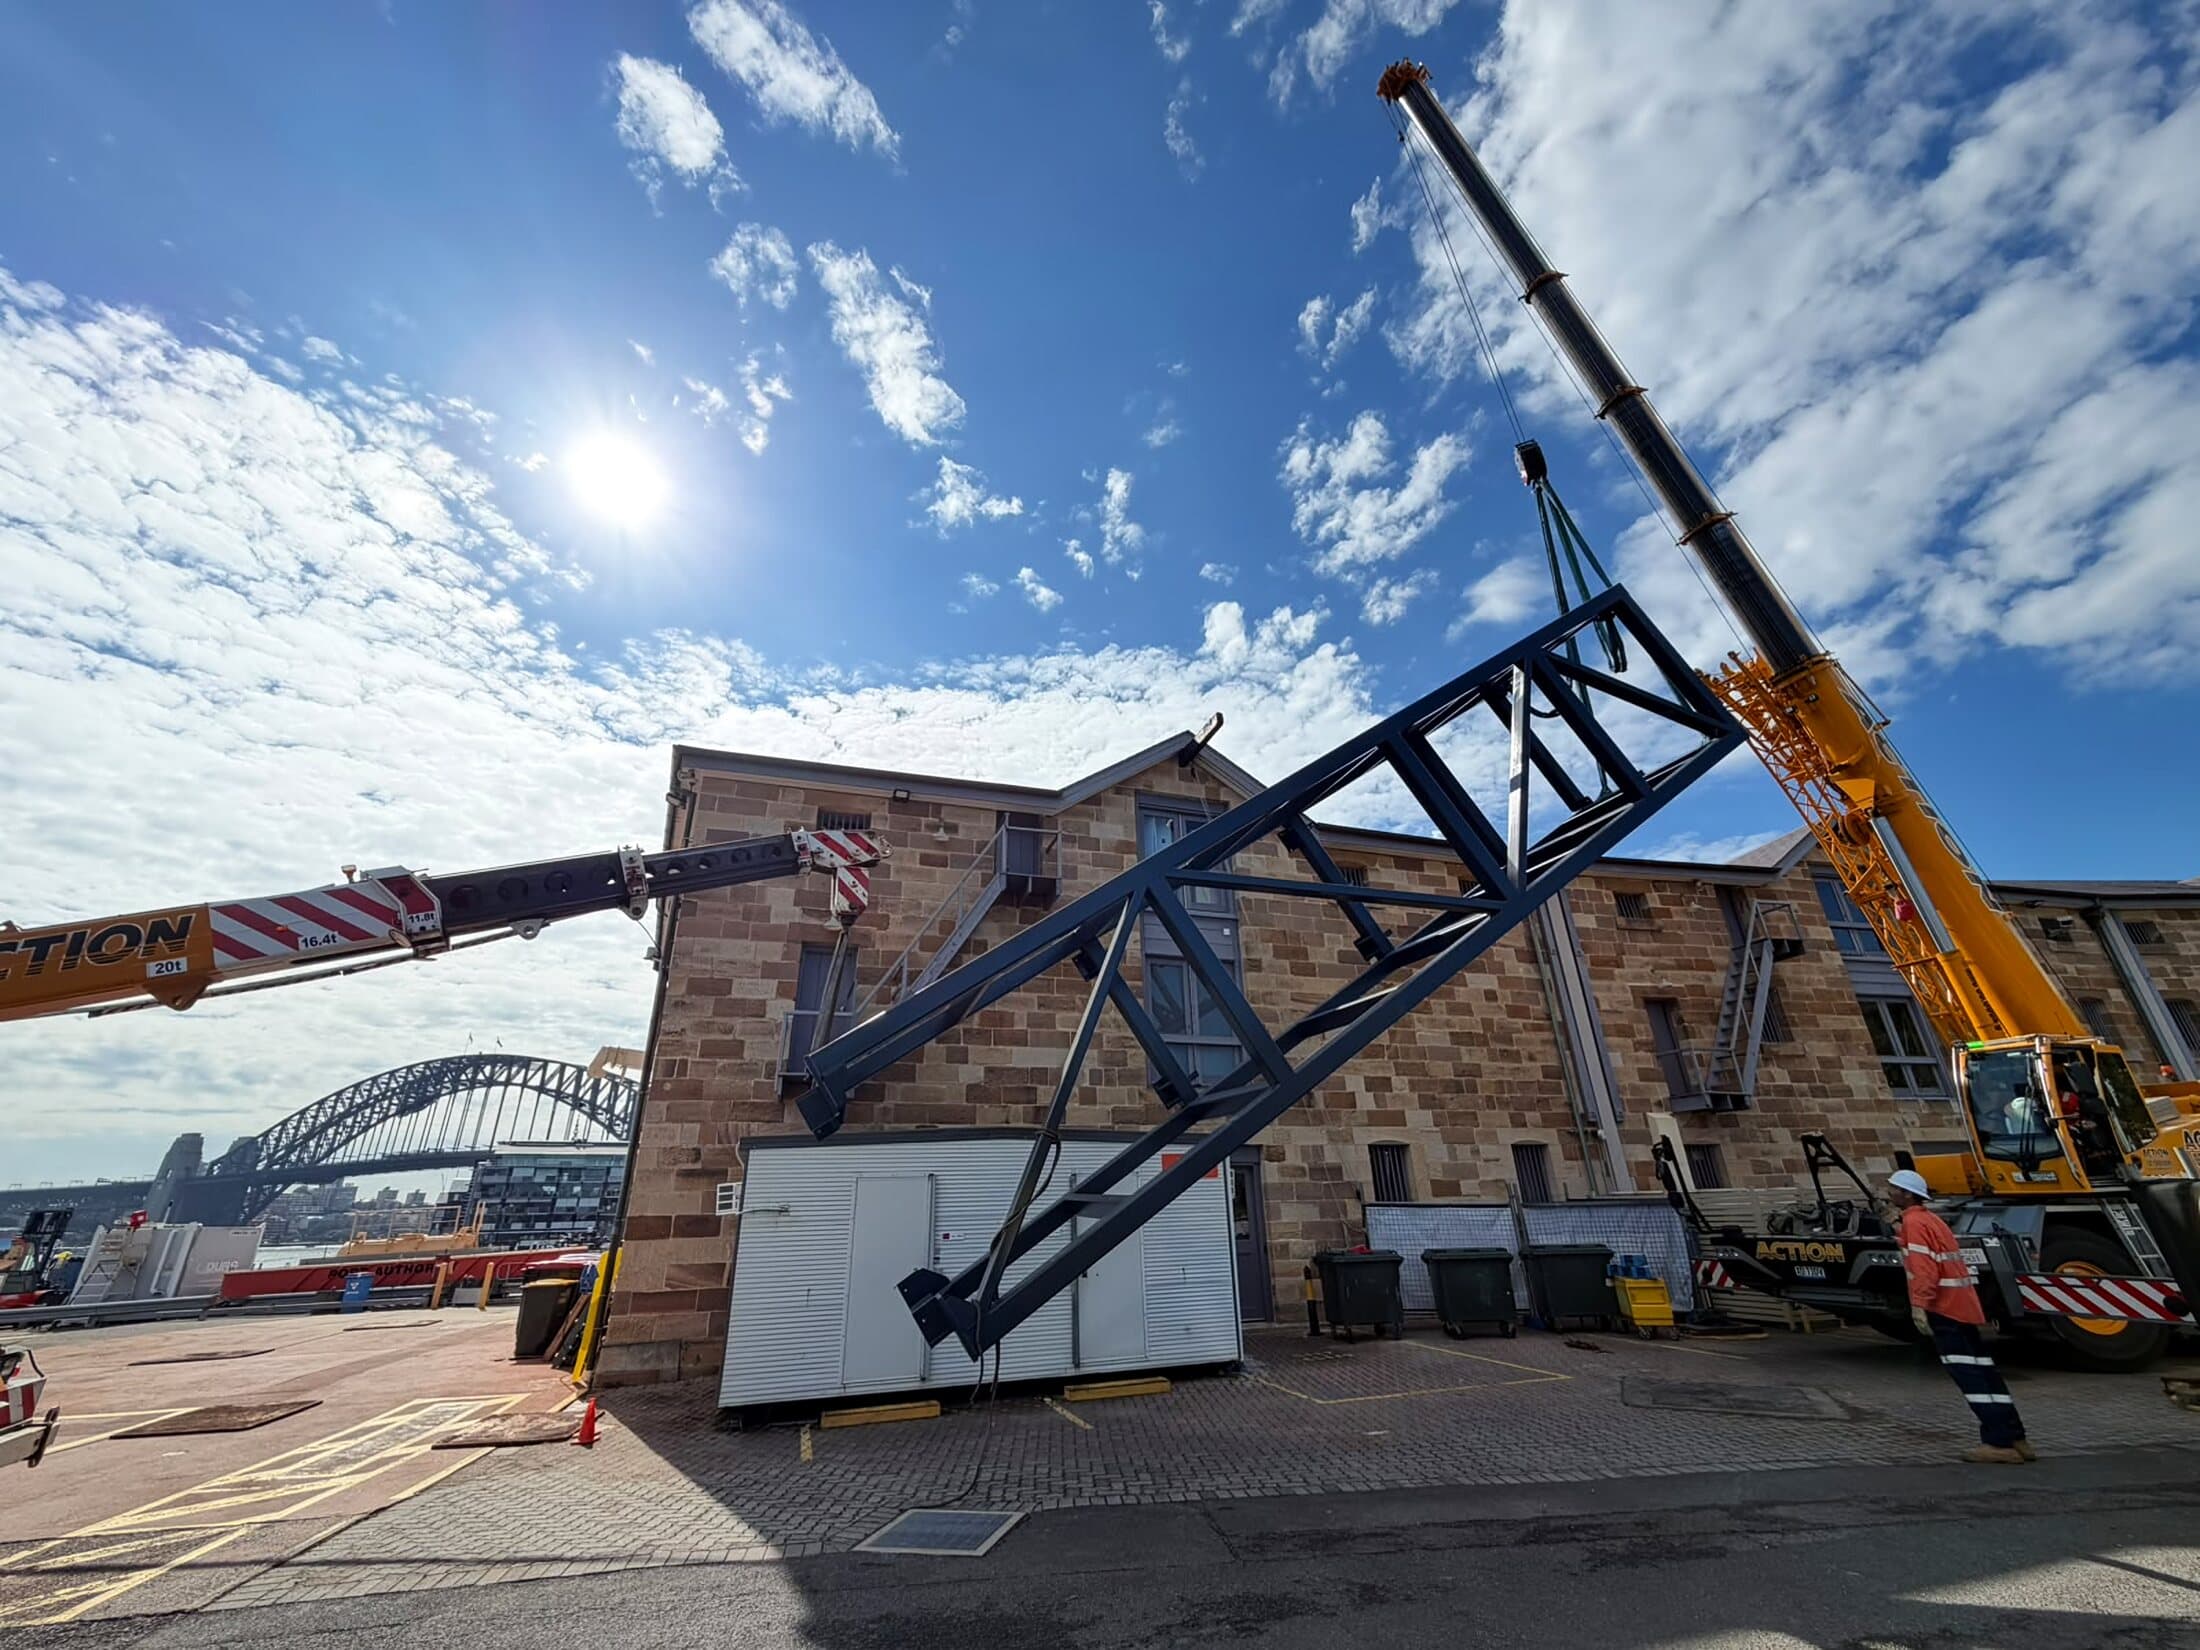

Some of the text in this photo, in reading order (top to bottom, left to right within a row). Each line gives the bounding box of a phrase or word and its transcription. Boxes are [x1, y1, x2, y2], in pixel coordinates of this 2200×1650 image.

[301, 933, 337, 949] 16.4t
[155, 960, 183, 975] 20t
[1756, 1241, 1845, 1263] ACTION
